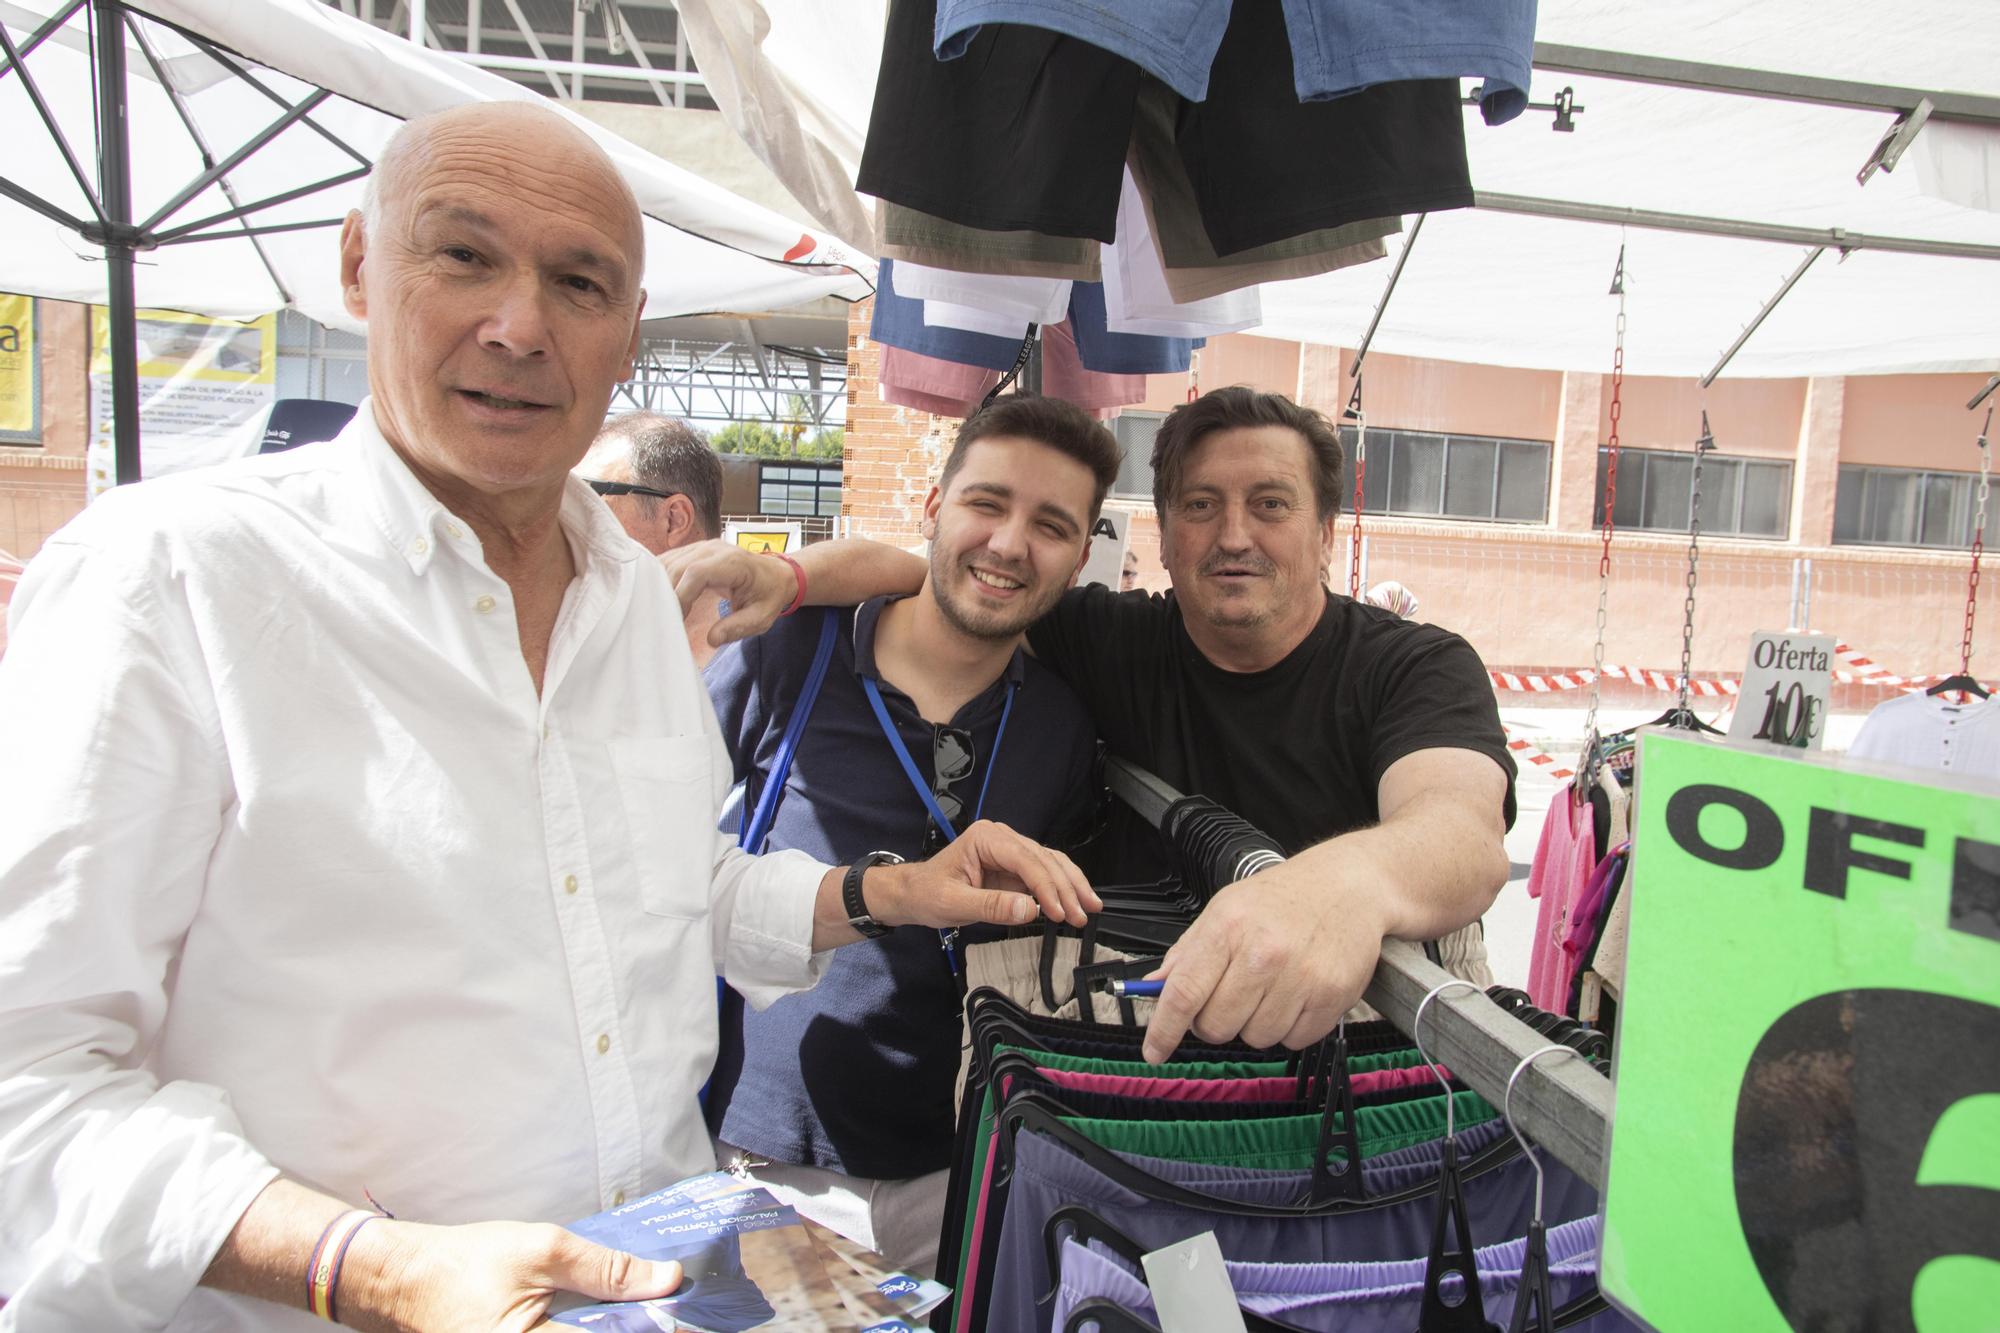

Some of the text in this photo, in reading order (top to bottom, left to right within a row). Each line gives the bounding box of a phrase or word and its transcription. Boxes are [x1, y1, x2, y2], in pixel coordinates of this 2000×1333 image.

[1020, 334, 1035, 362] LEAGUE
[1754, 639, 1828, 672] Oferta
[656, 1211, 778, 1235] PALACIOS TORTOLA
